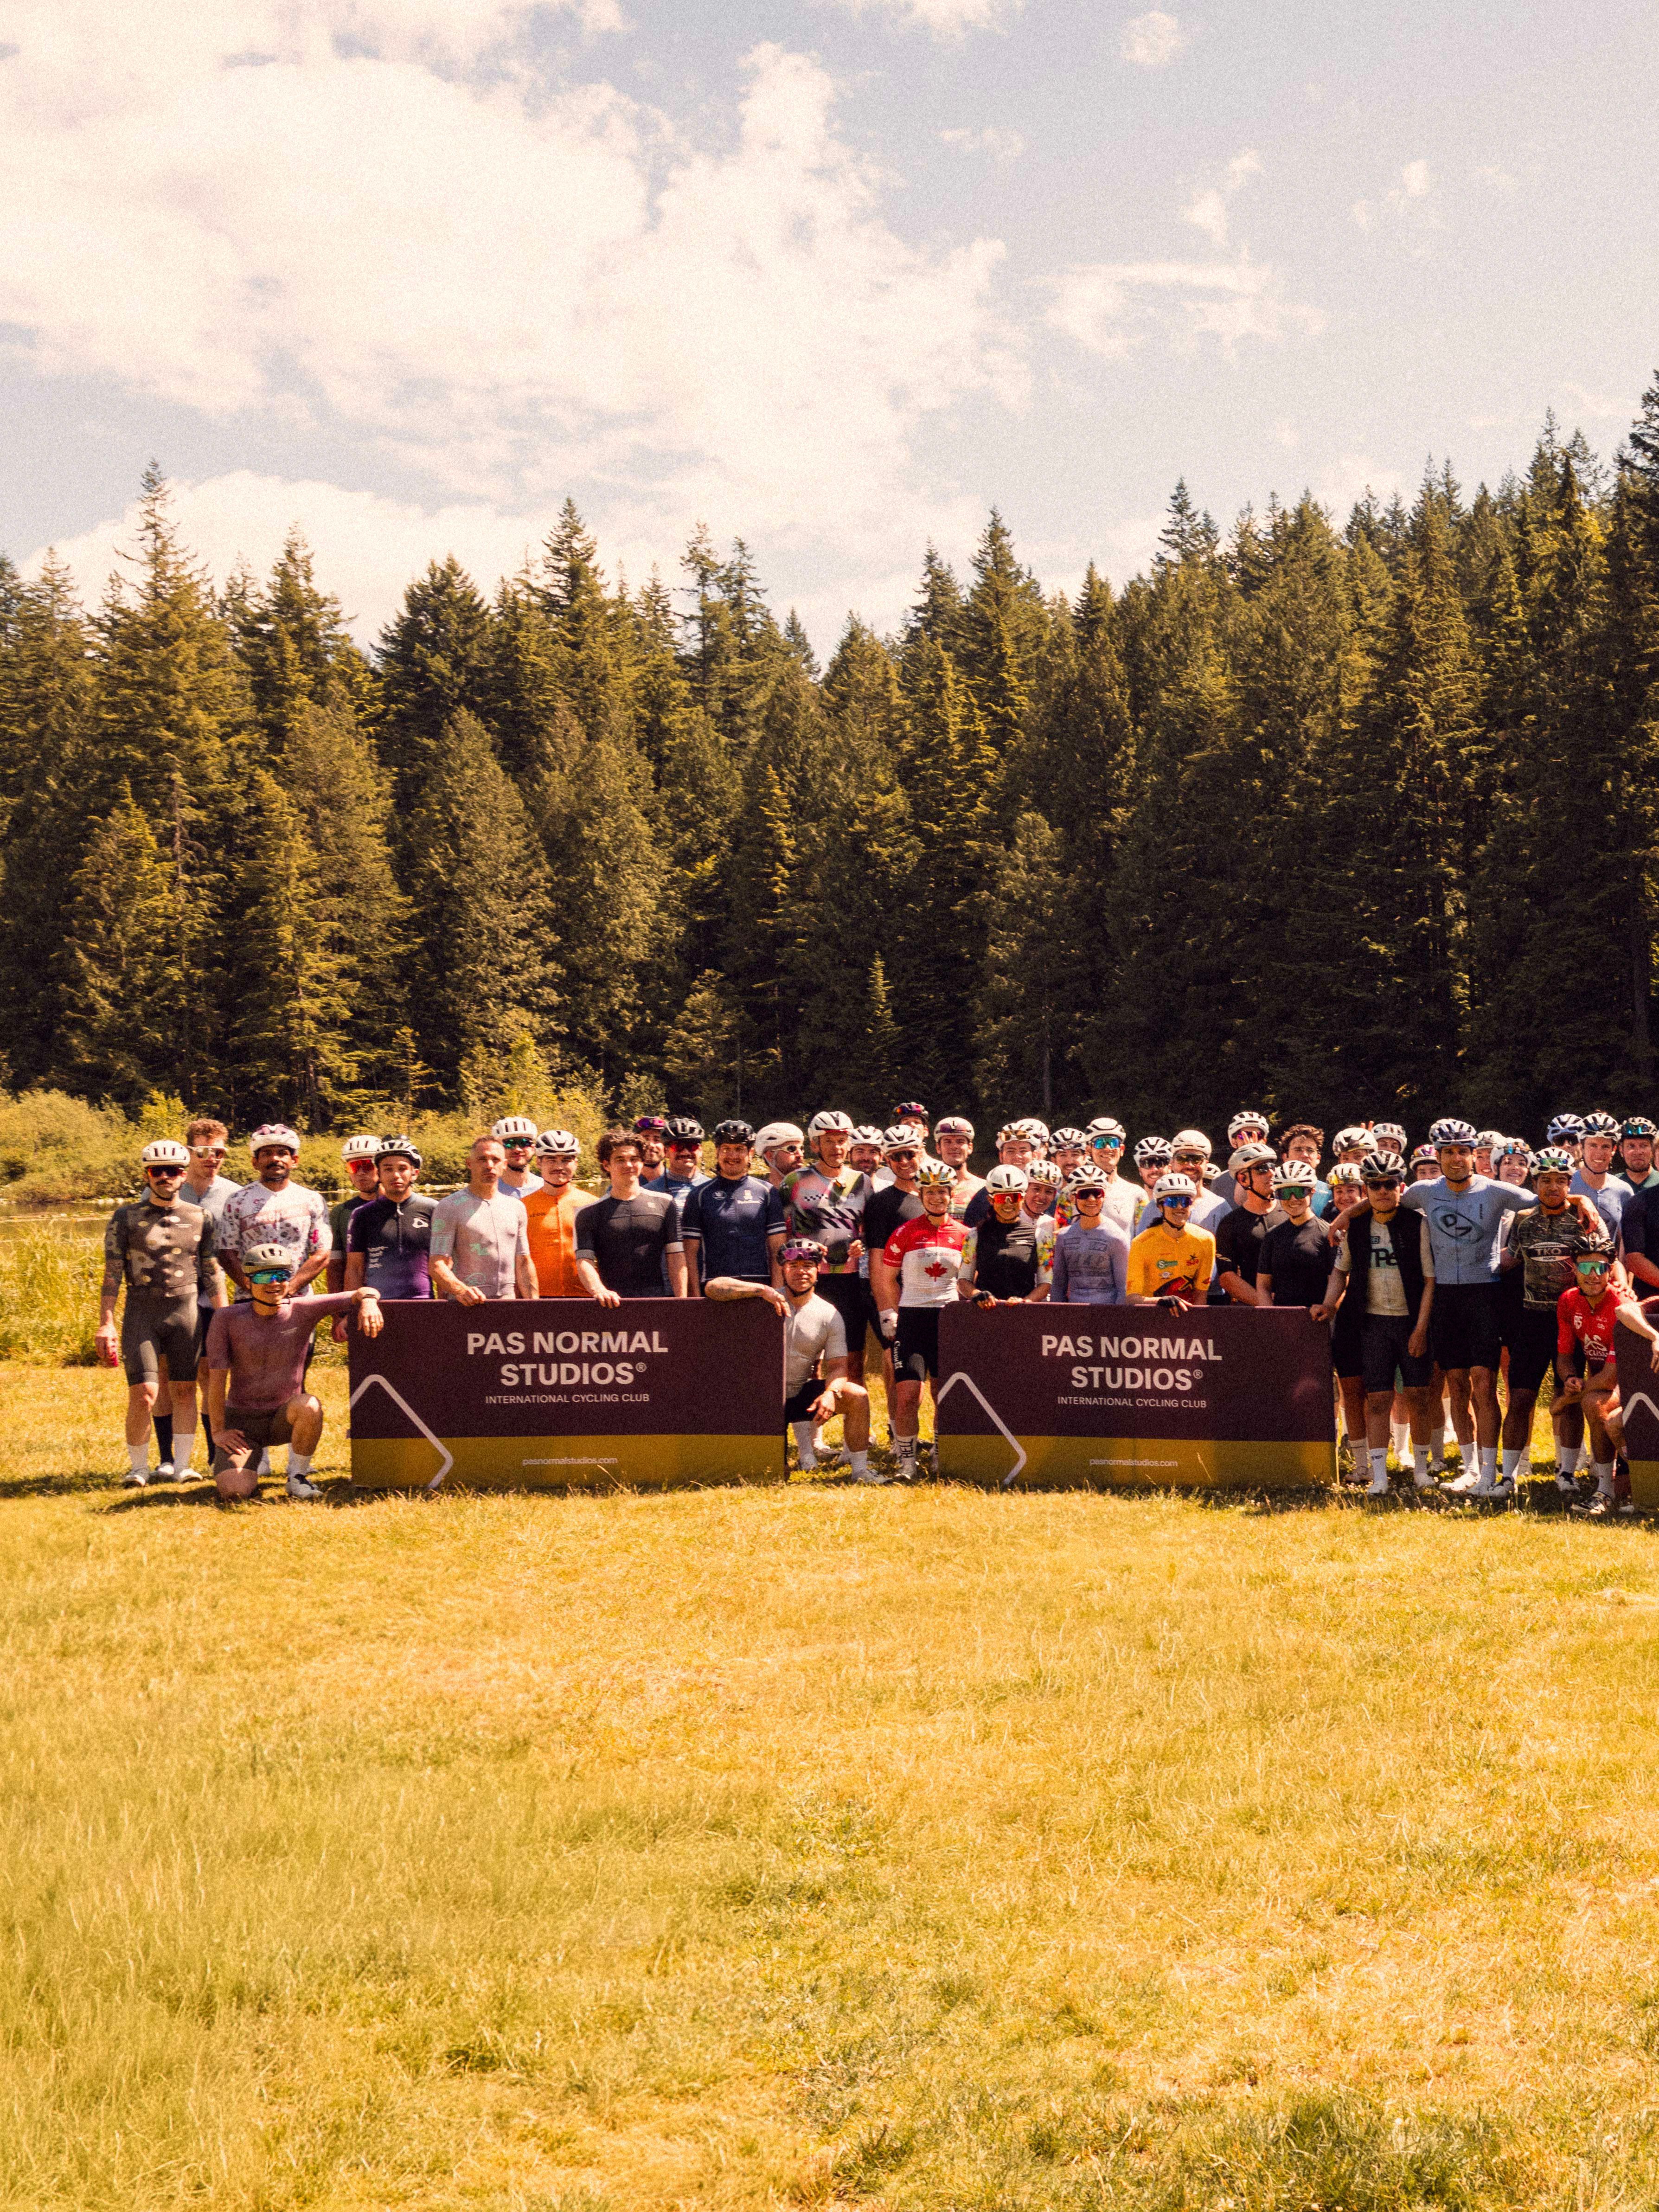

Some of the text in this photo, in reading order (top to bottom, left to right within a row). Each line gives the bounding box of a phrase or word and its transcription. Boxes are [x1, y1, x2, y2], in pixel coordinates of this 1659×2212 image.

[467, 1331, 668, 1355] PAS NORMAL
[1042, 1335, 1223, 1360] PAS NORMAL
[485, 1394, 649, 1404] INTERNATIONAL CYCLING CLUB
[1057, 1397, 1207, 1408] INTERNATIONAL CYCLING CLUB
[522, 1456, 618, 1466] pasnormalstudios.com
[1089, 1458, 1179, 1467] pasnormalstudios.com
